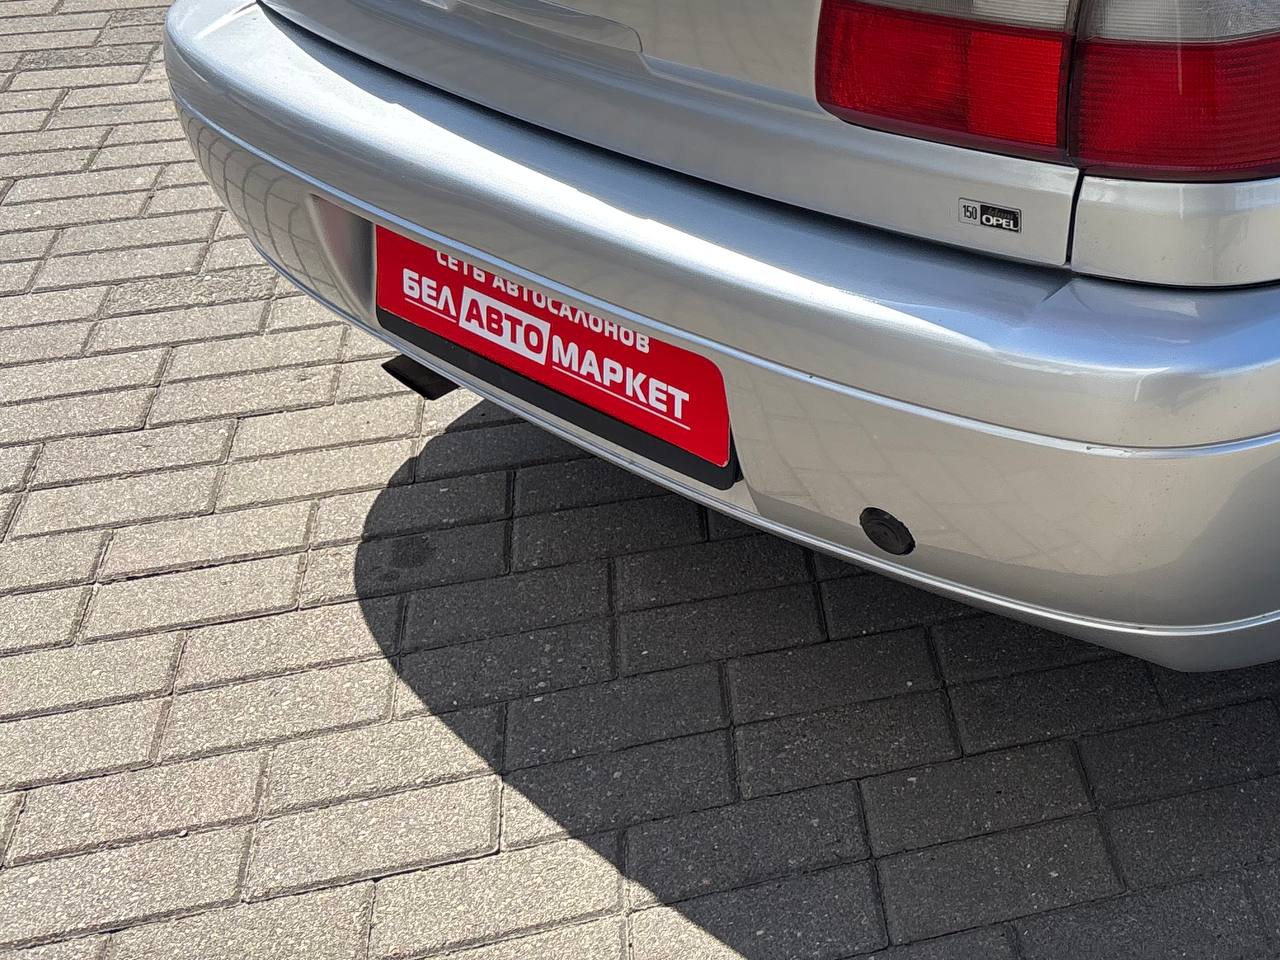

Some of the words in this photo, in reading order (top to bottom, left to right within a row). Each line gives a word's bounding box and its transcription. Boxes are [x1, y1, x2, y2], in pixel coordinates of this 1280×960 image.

[962, 204, 978, 220] 150
[981, 214, 1020, 231] OPEL
[492, 274, 650, 354] АВТОСАЛОНОВ
